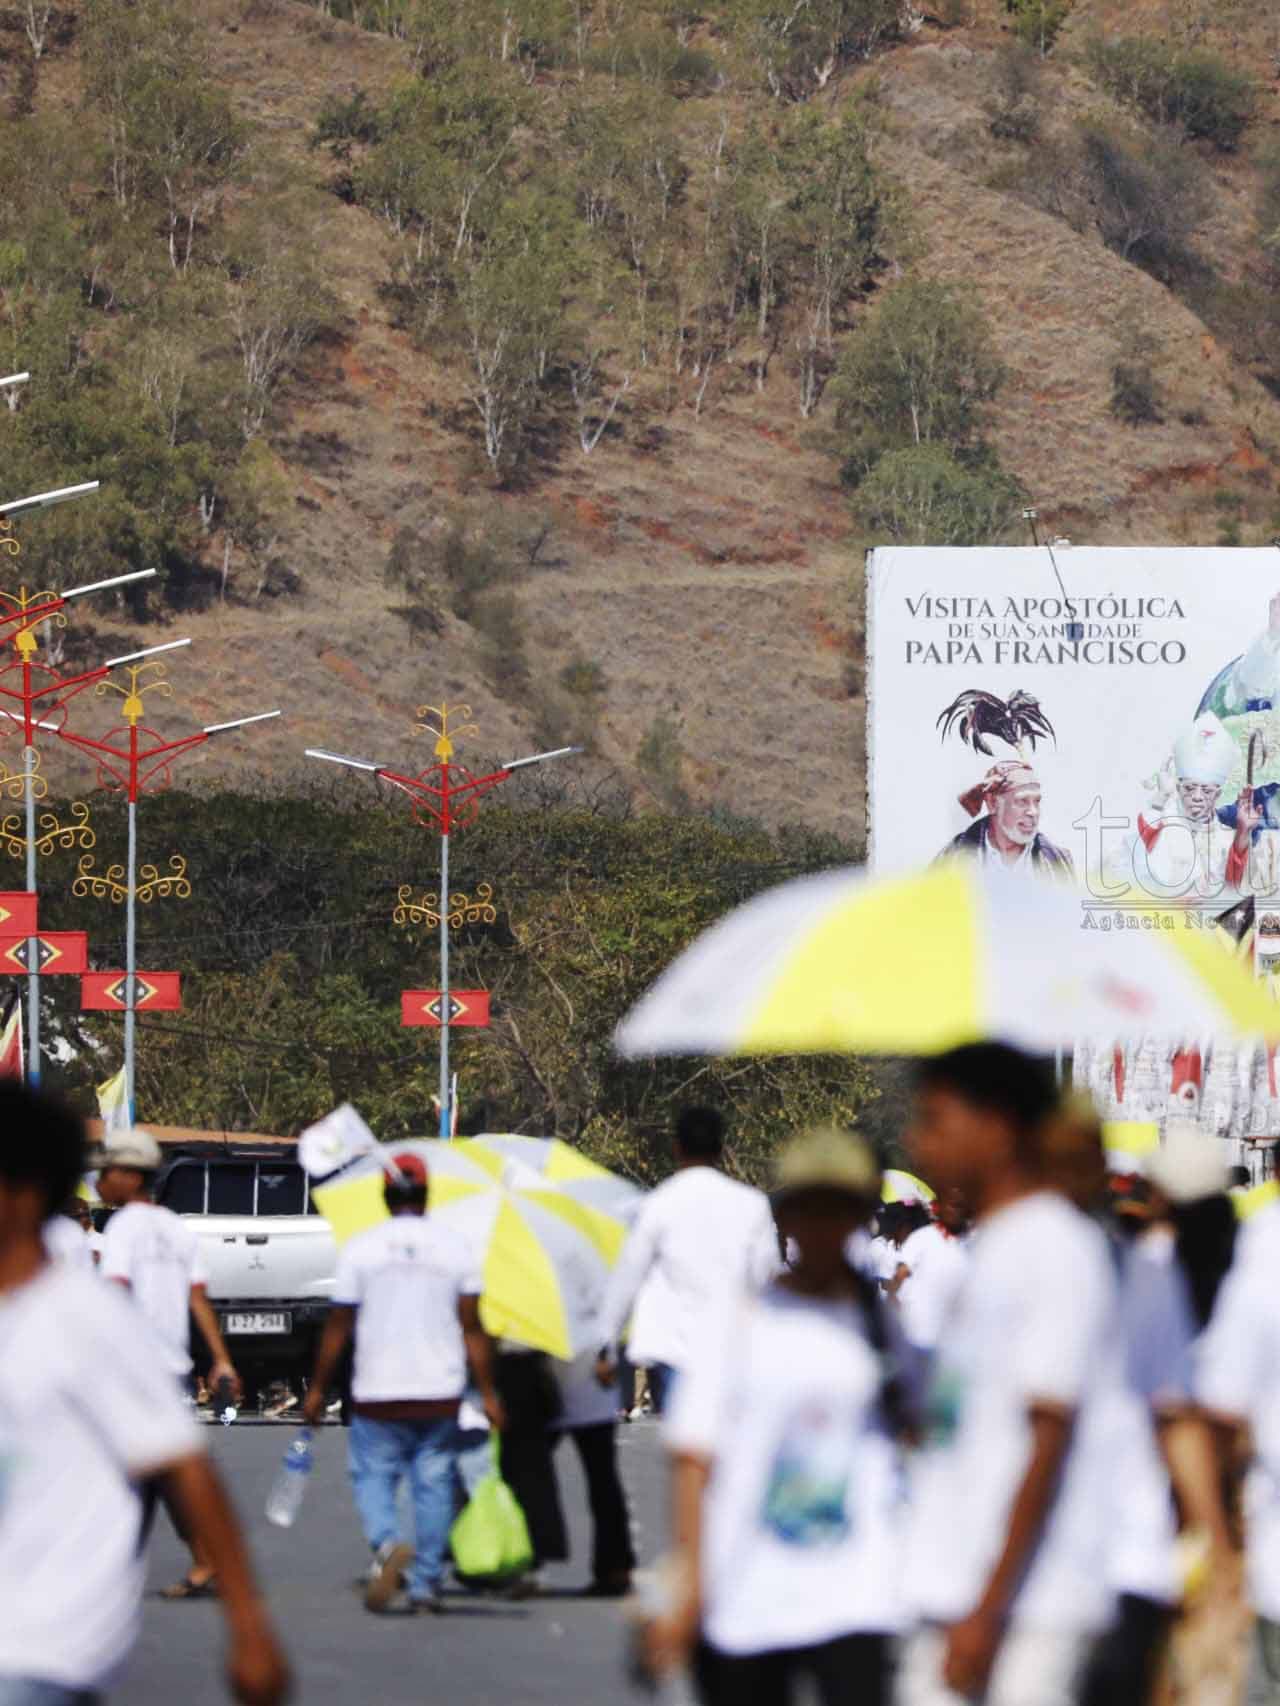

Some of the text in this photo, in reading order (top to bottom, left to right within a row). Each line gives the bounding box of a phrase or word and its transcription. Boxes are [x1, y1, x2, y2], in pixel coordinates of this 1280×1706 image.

[949, 623, 1142, 640] DE SUA SANDADE
[905, 640, 1187, 665] PAPA FRANCISCO
